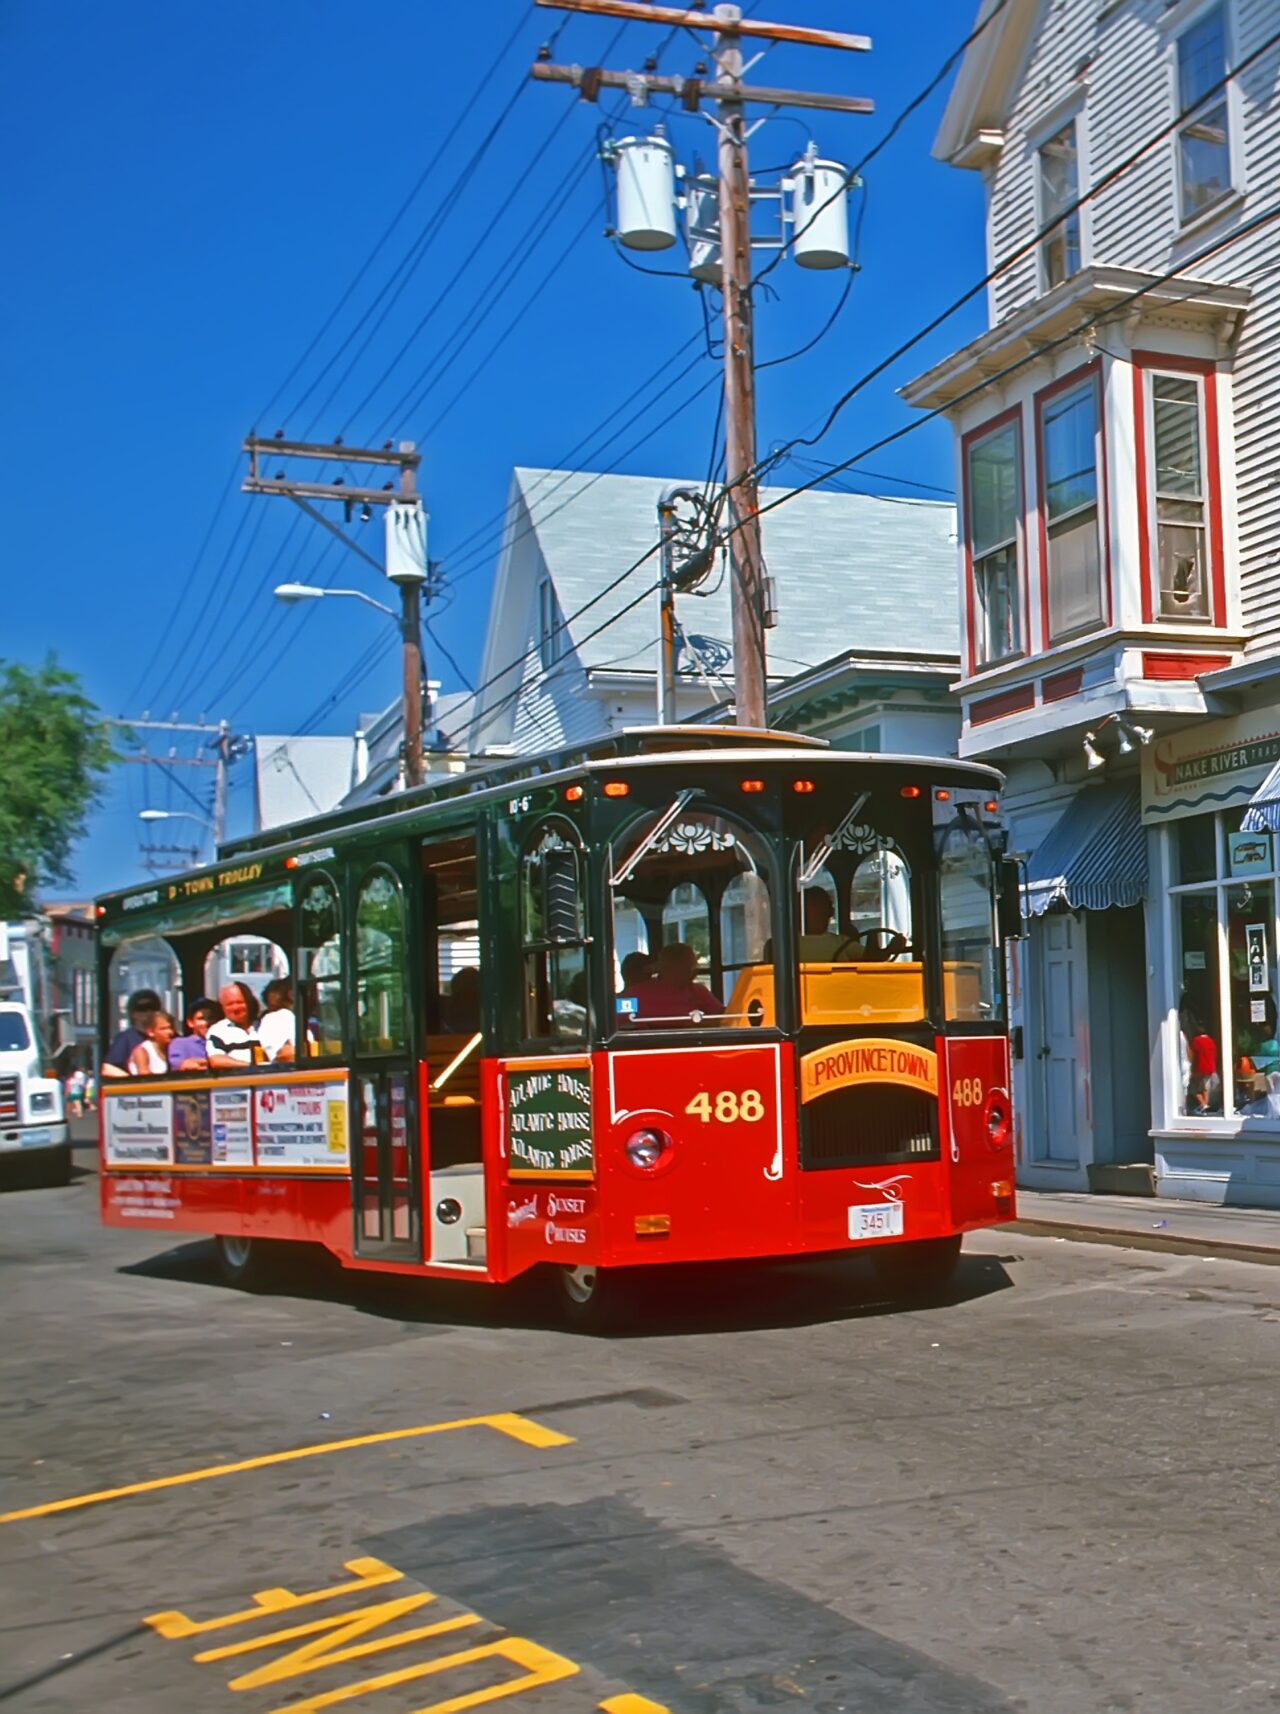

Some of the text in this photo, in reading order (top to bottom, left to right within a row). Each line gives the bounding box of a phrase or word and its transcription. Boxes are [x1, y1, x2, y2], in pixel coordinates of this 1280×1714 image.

[1211, 751, 1248, 773] RIVER
[184, 877, 214, 896] TOWN
[218, 864, 262, 887] TROLLEY
[814, 1047, 929, 1086] PROVINCETOWN
[260, 1090, 276, 1113] 40
[509, 1073, 591, 1107] ATLANTIC HOUSE
[952, 1077, 983, 1106] 488
[297, 1102, 322, 1115] TOURS
[684, 1089, 765, 1123] 488
[511, 1112, 590, 1132] ATLANTIC HOUSE
[511, 1137, 592, 1169] ATLANTIC HOUSE
